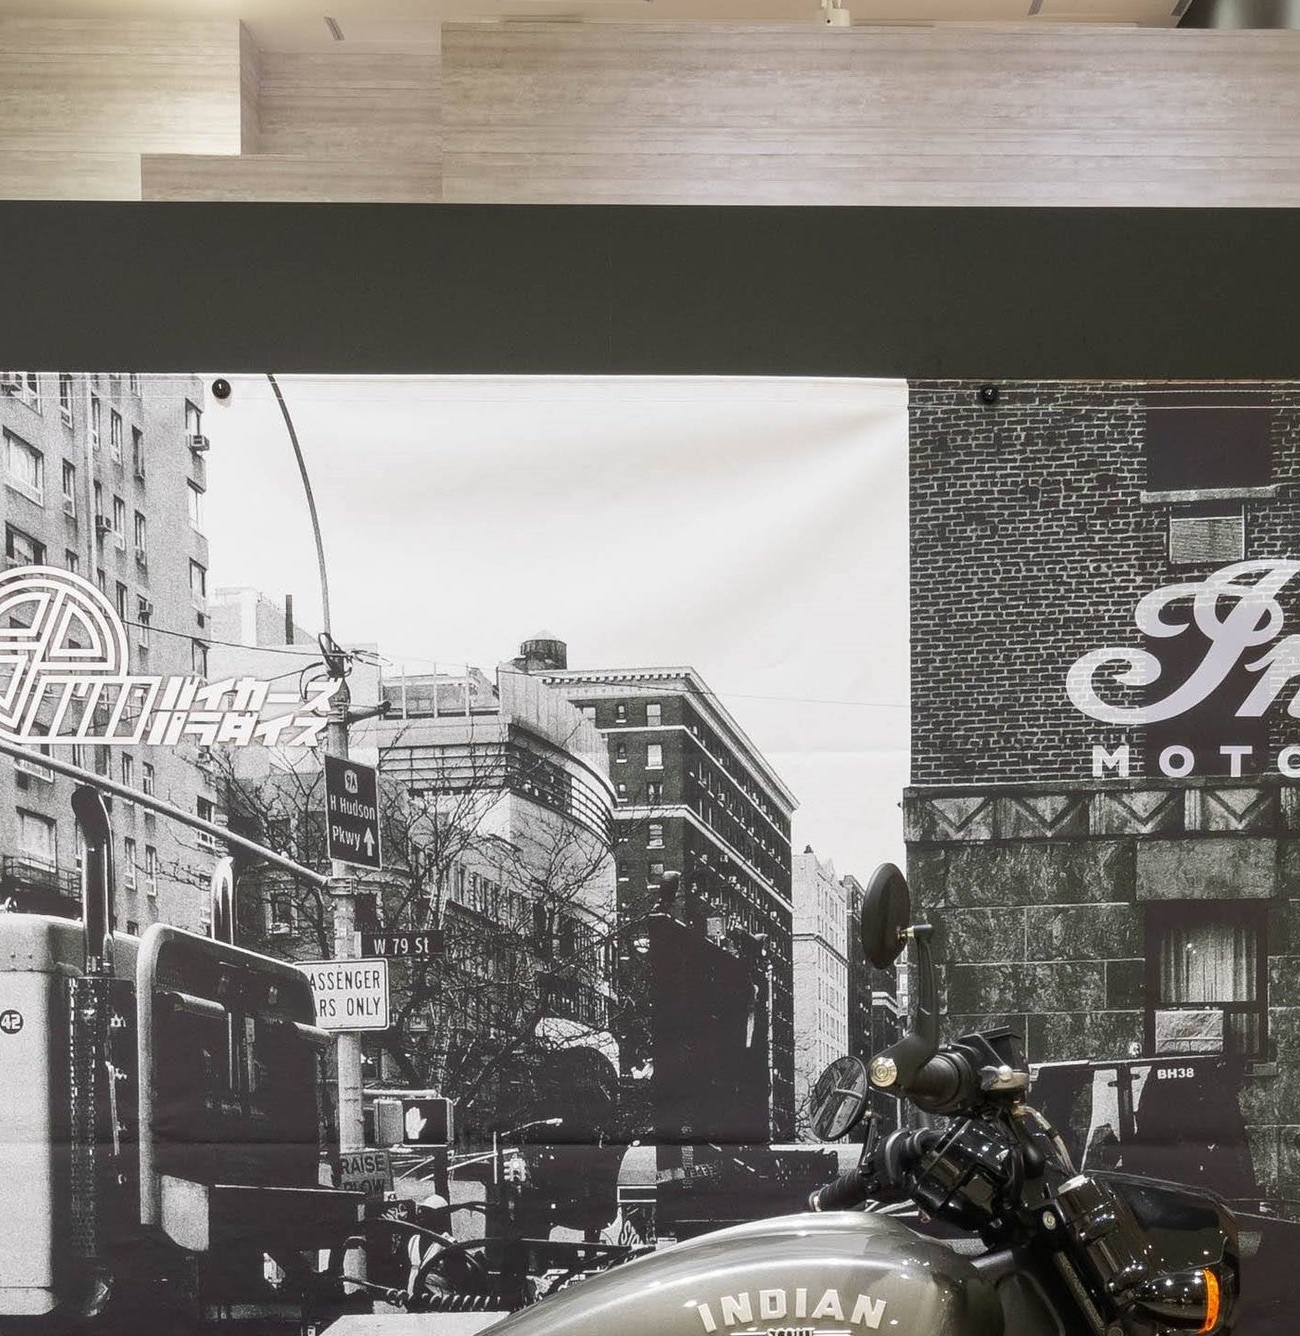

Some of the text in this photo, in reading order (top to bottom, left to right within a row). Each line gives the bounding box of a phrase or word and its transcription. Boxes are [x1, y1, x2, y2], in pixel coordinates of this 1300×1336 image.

[162, 676, 343, 712] バイカーズ
[147, 711, 330, 746] パラダイス
[340, 796, 376, 821] Hudson
[332, 825, 361, 851] Pkwy
[373, 936, 430, 954] W 79 St
[309, 969, 381, 991] ASSENGER
[346, 997, 381, 1016] ONLY
[1, 1013, 21, 1030] 42
[1157, 1067, 1195, 1080] BH38
[341, 1153, 385, 1175] RAISE
[697, 1287, 887, 1333] INDIAN
